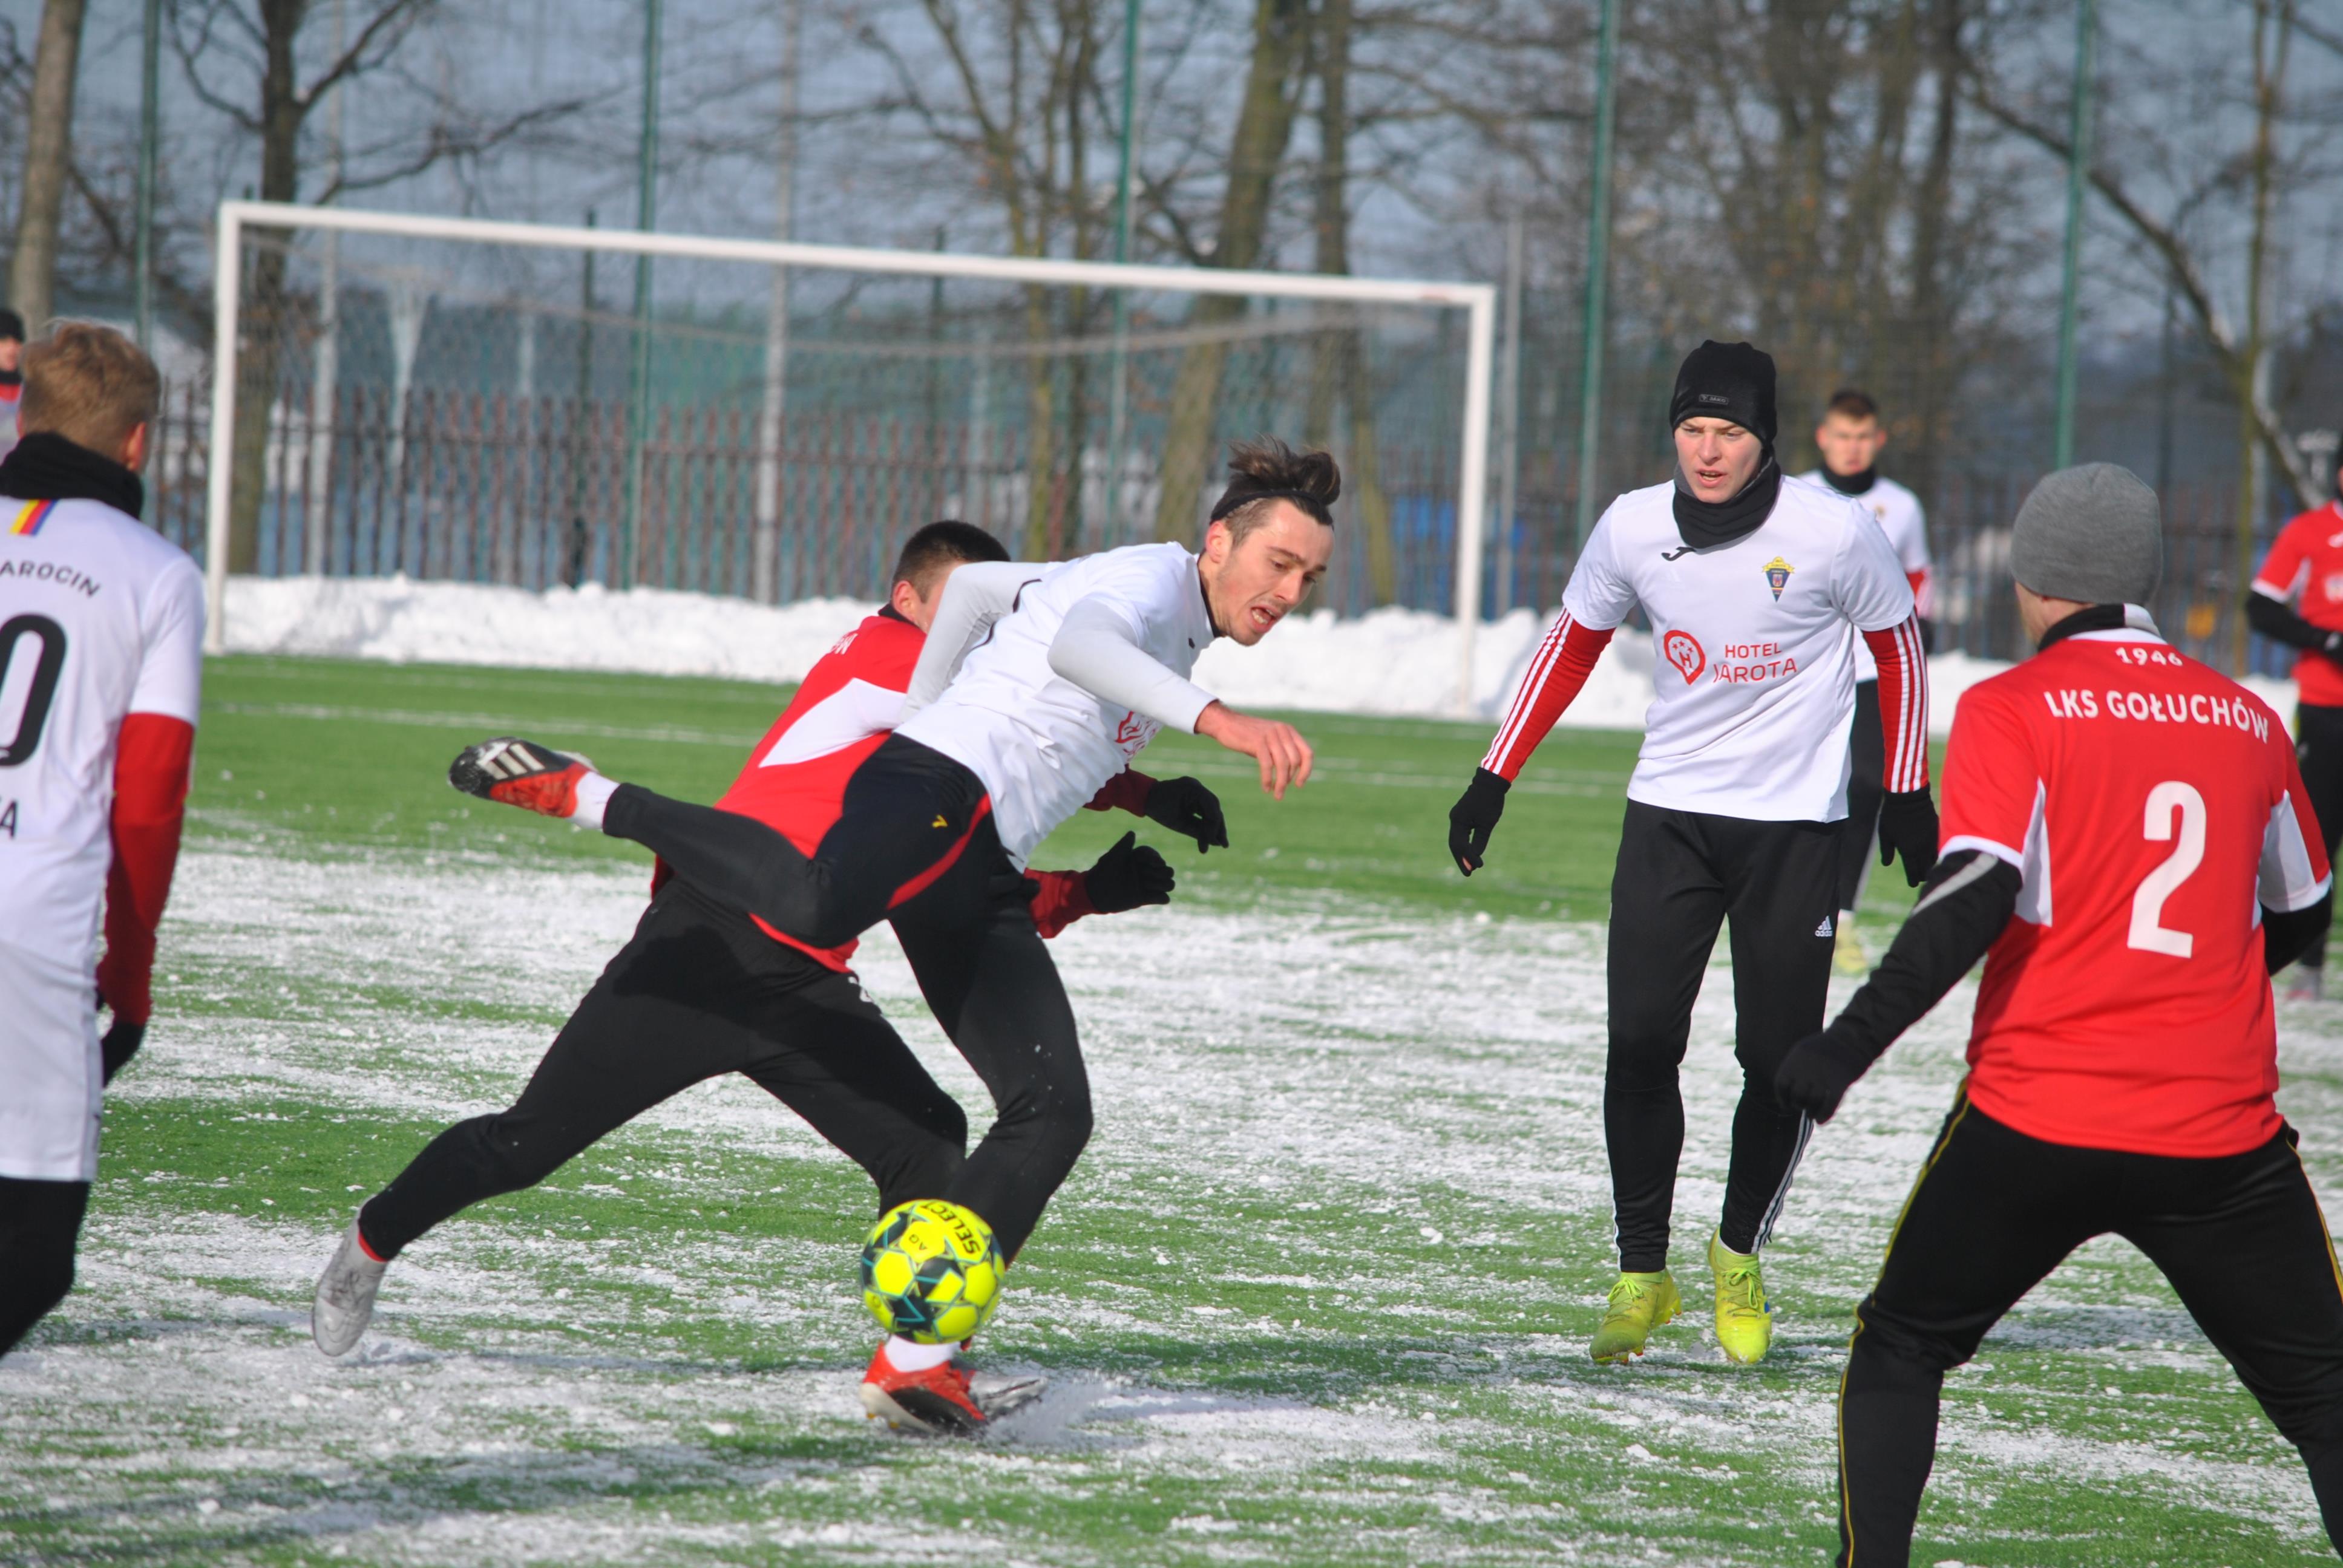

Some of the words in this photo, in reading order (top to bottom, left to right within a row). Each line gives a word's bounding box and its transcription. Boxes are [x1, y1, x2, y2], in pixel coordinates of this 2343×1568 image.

[1725, 642, 1782, 659] HOTEL
[2115, 646, 2183, 666] 1946
[1713, 658, 1797, 683] JAROTA
[2043, 689, 2099, 719] LKS
[2105, 690, 2269, 744] GOŁUCHÓW
[2126, 780, 2207, 959] 2
[919, 1201, 981, 1255] SELECT
